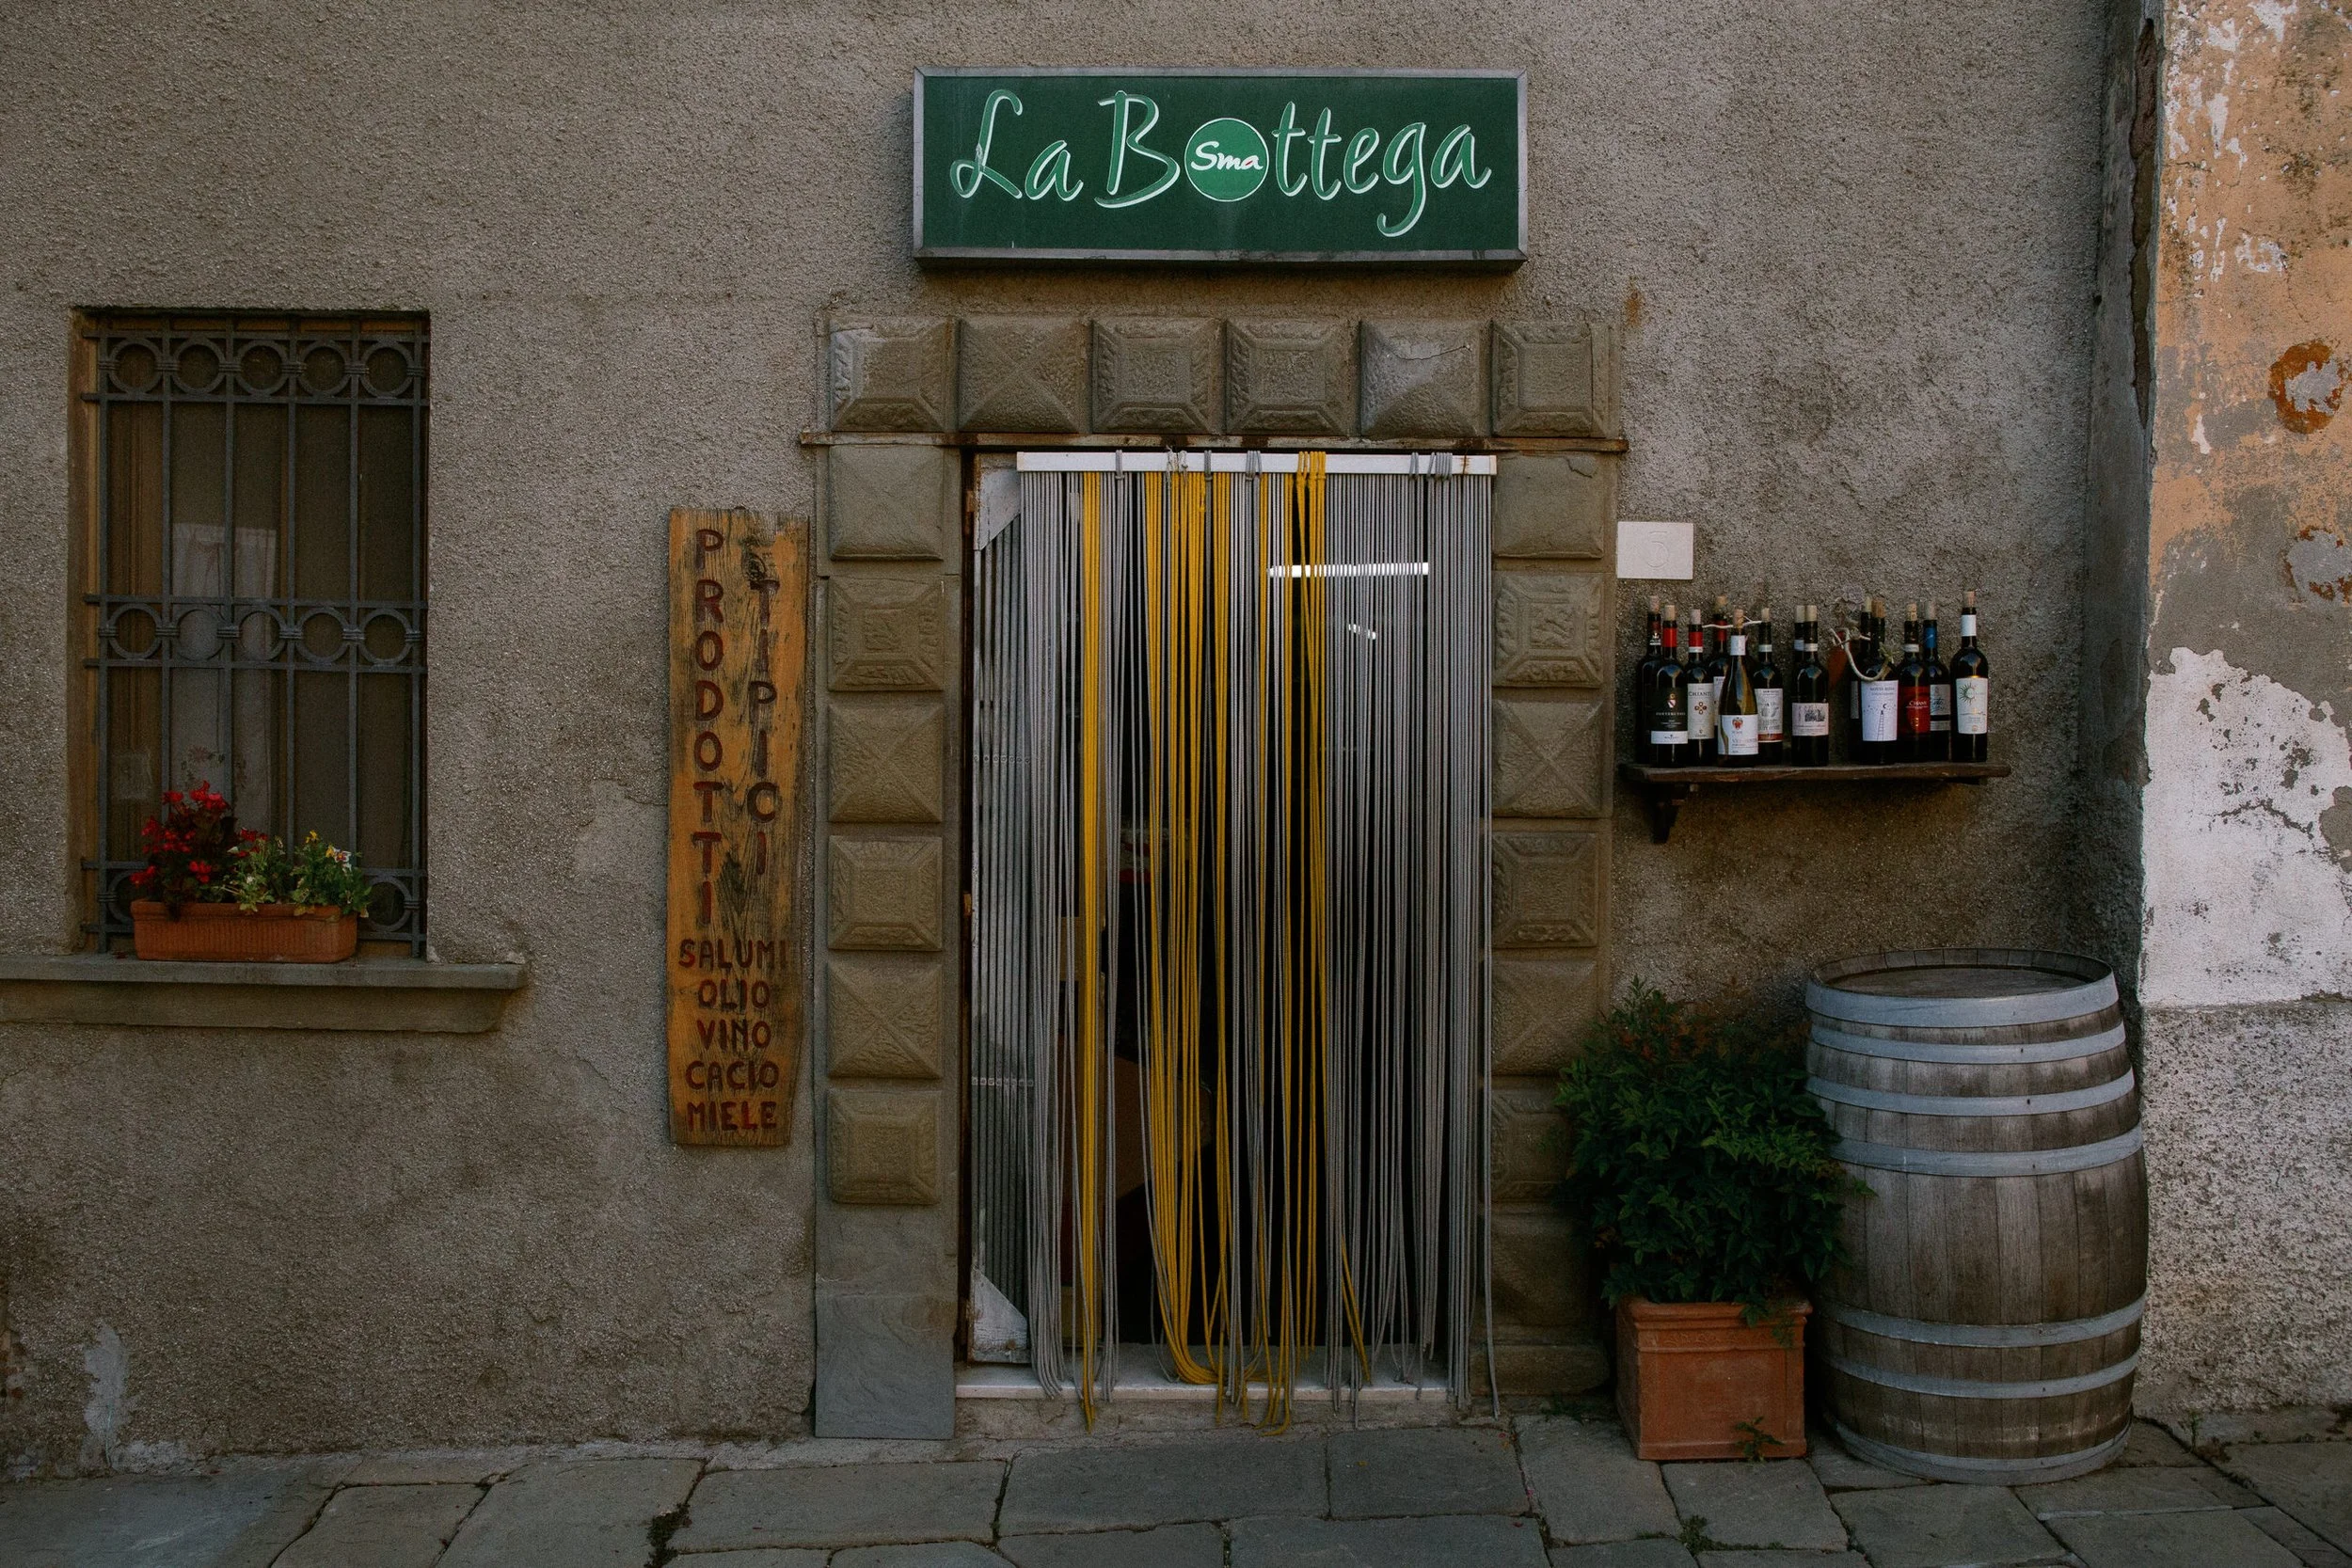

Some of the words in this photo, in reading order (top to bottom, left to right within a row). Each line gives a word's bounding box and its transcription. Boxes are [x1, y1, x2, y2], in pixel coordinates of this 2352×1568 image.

[950, 89, 1084, 201] La
[1191, 140, 1264, 172] Sma
[692, 529, 724, 926] PRODOTTI
[748, 579, 781, 876] TIPICI
[678, 939, 787, 969] SALUMI
[697, 978, 770, 1010] OLIO
[696, 1019, 771, 1052] VINO
[685, 1060, 779, 1090] CACIO
[687, 1101, 777, 1129] MIELE
